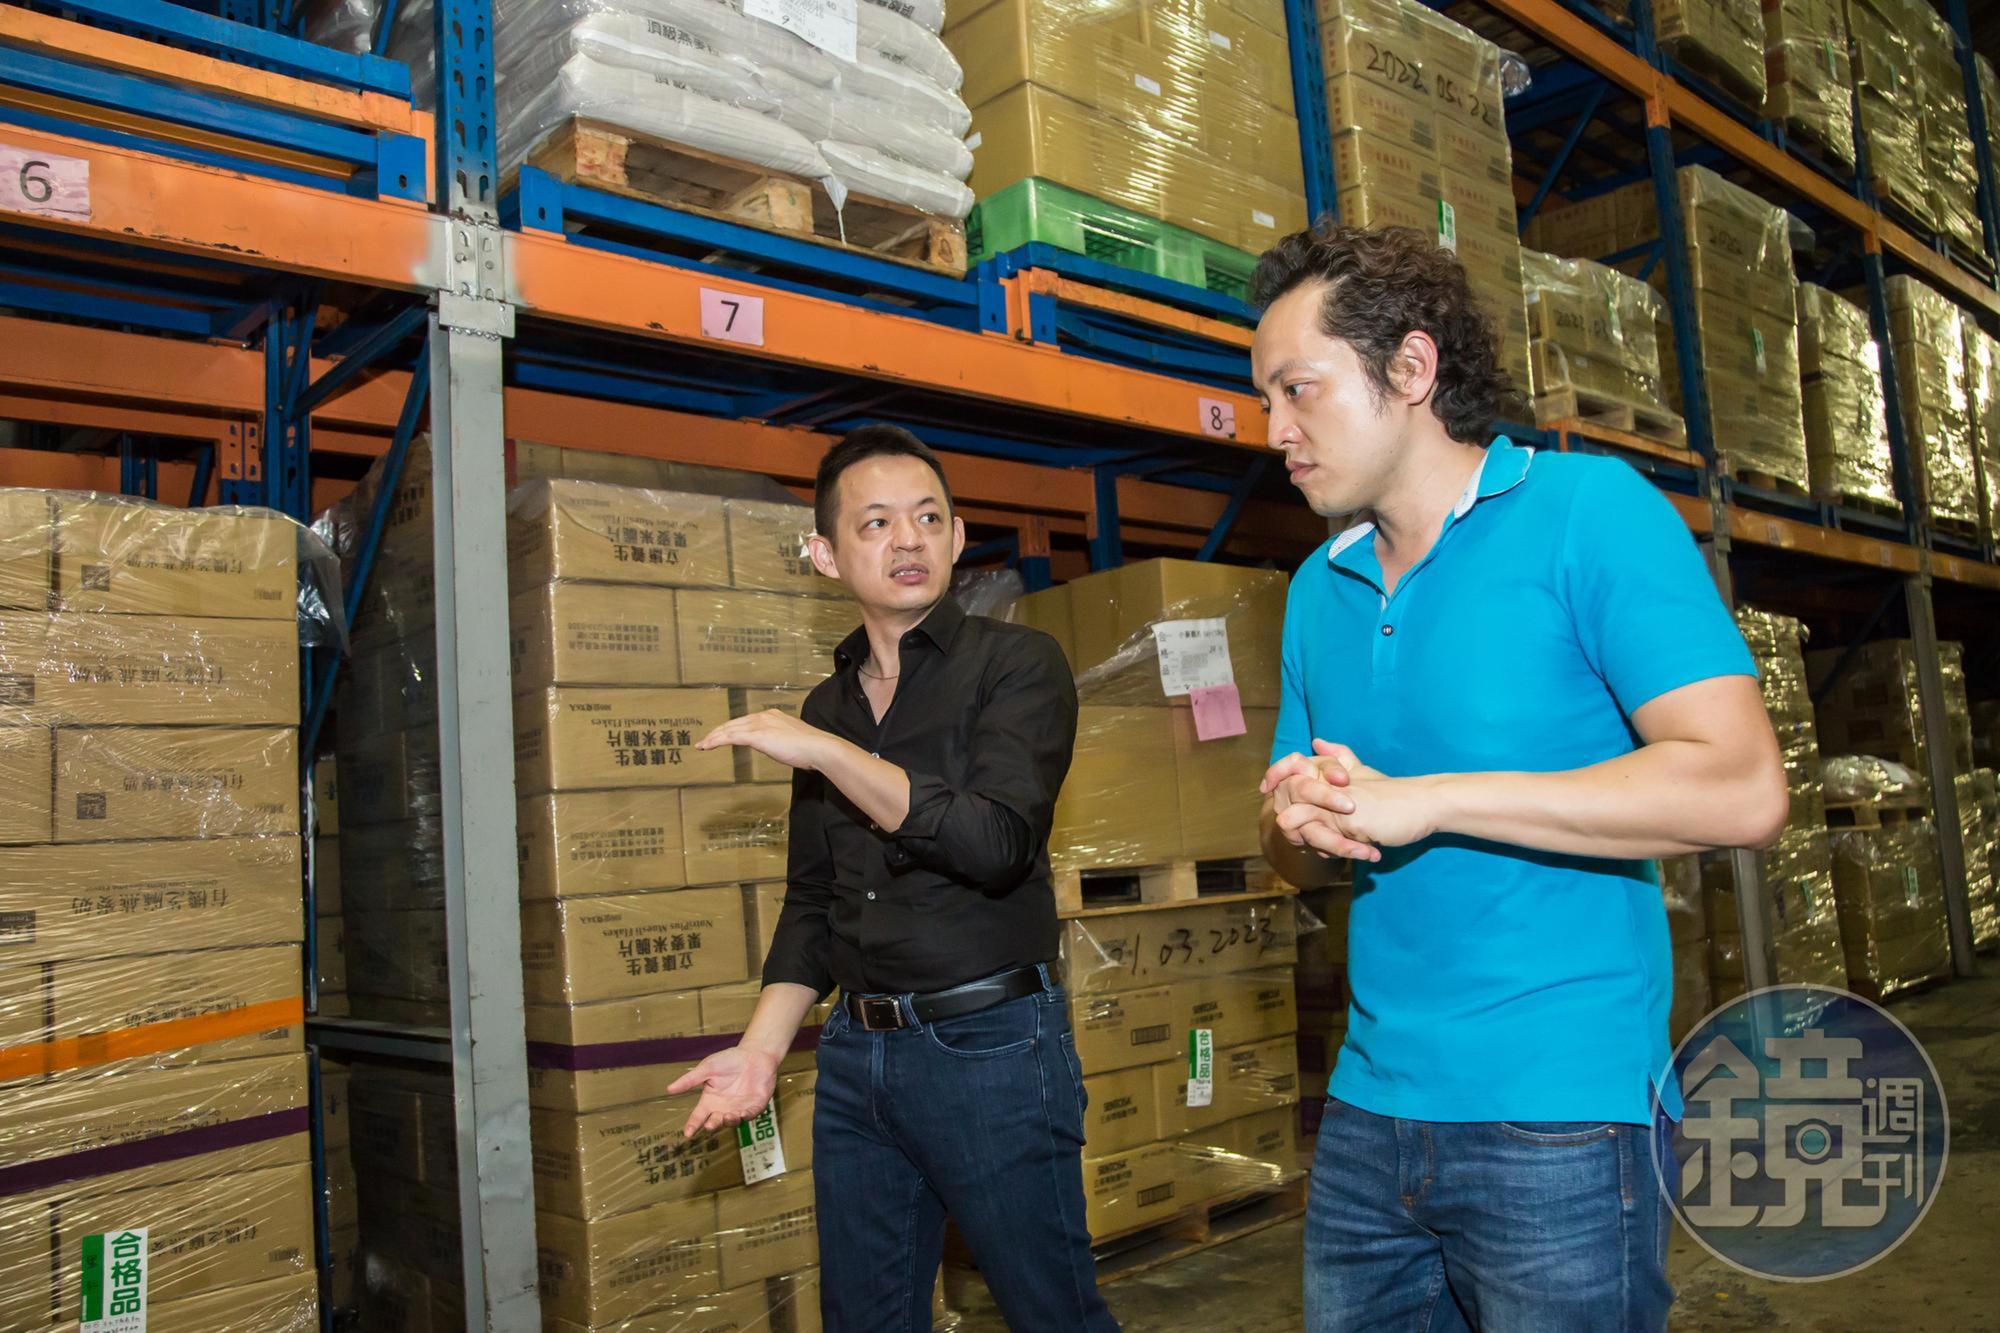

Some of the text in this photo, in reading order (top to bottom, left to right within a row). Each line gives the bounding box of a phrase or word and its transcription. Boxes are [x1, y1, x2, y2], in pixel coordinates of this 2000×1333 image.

[20, 161, 52, 202] 6
[719, 300, 740, 332] 7
[1210, 404, 1223, 430] 8
[607, 526, 688, 548] 果麥米脆片
[613, 544, 680, 565] 立康養生
[591, 718, 622, 728] Flakes
[624, 718, 657, 728] Muesli
[606, 729, 691, 747] 果麥米脆片
[615, 748, 683, 766] 立康養生
[72, 887, 229, 916] 有機芝麻燕麥奶
[602, 928, 634, 938] Flakes
[618, 932, 702, 958] 果麥米脆片
[626, 951, 694, 976] 立康養生
[1199, 1030, 1211, 1079] 合格品
[152, 1225, 257, 1257] 有機芝麻燕麥
[110, 1231, 142, 1316] 合格品
